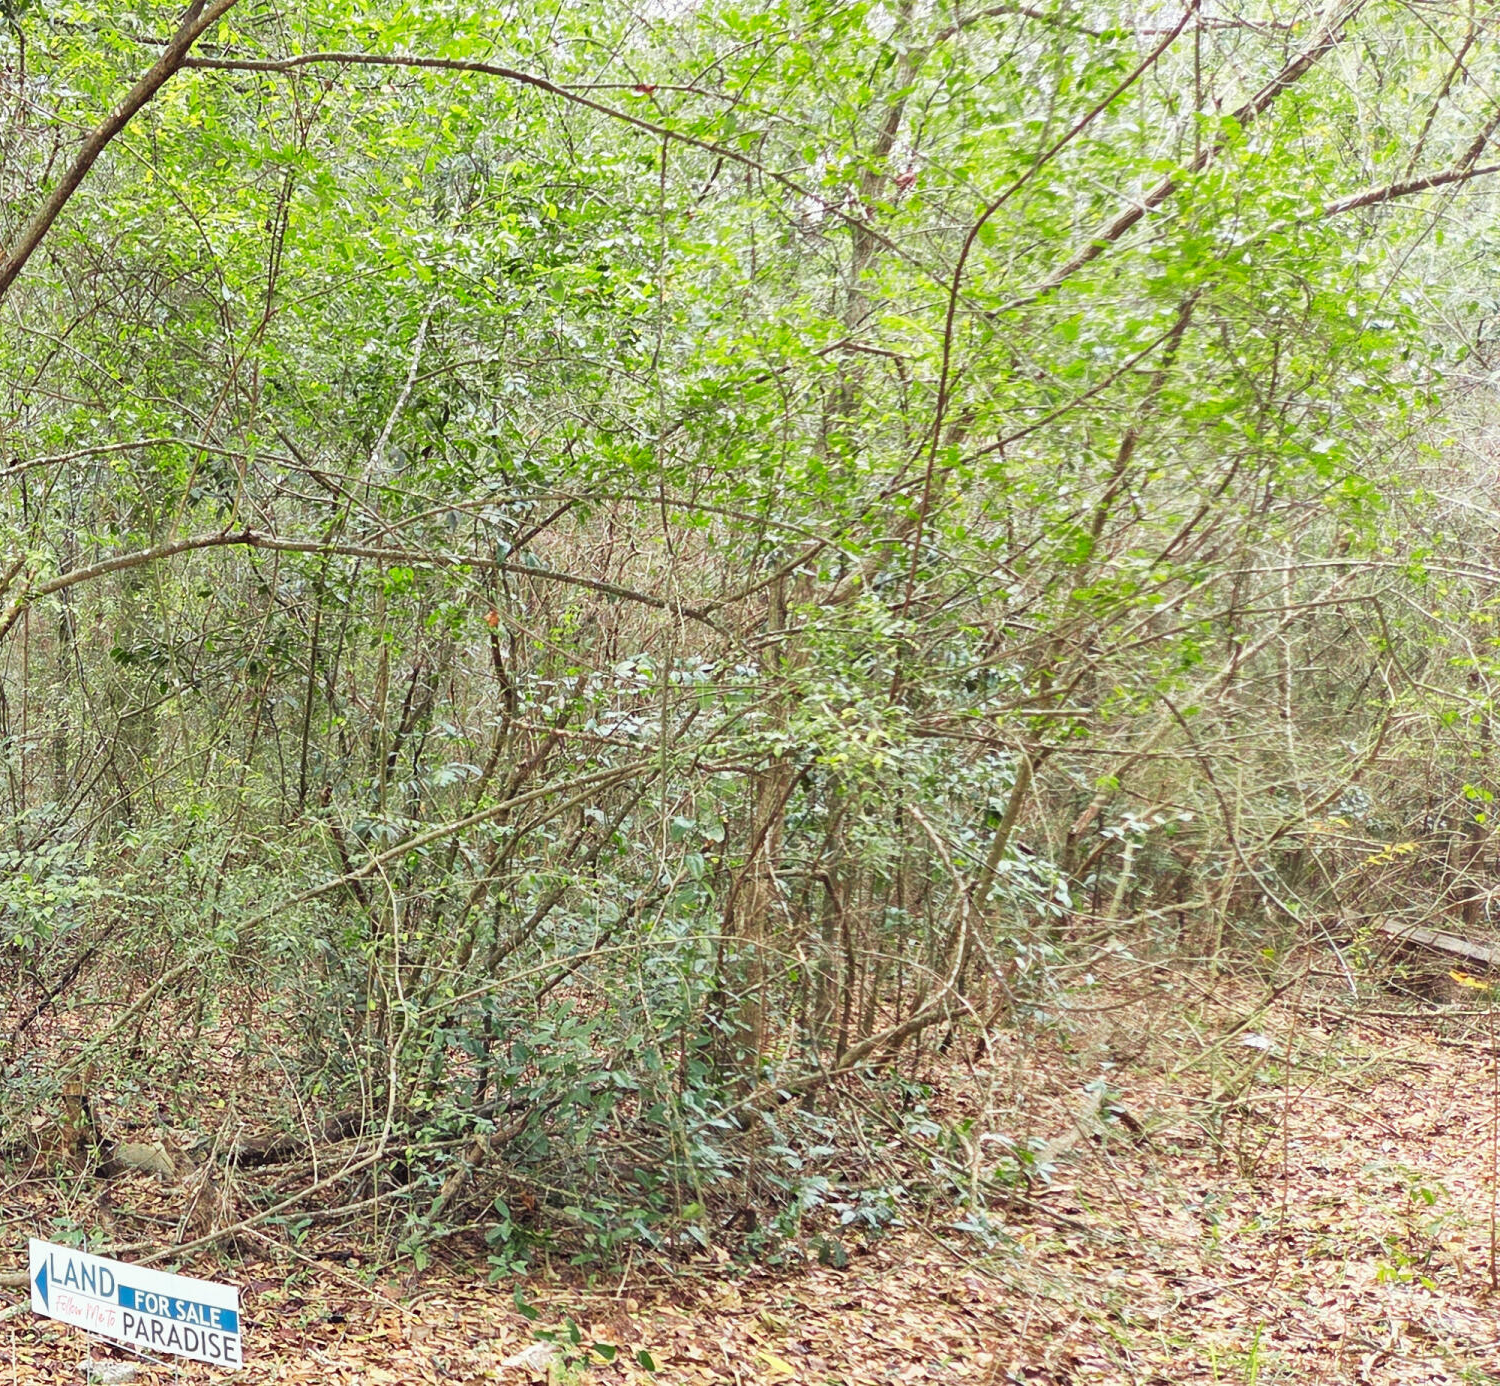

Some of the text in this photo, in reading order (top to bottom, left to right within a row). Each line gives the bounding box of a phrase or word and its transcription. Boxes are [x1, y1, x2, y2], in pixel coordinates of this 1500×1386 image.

[50, 1252, 222, 1330] LAND FOR SALE
[55, 1295, 83, 1316] Follow
[86, 1303, 104, 1327] Me
[123, 1312, 238, 1363] PARADISE
